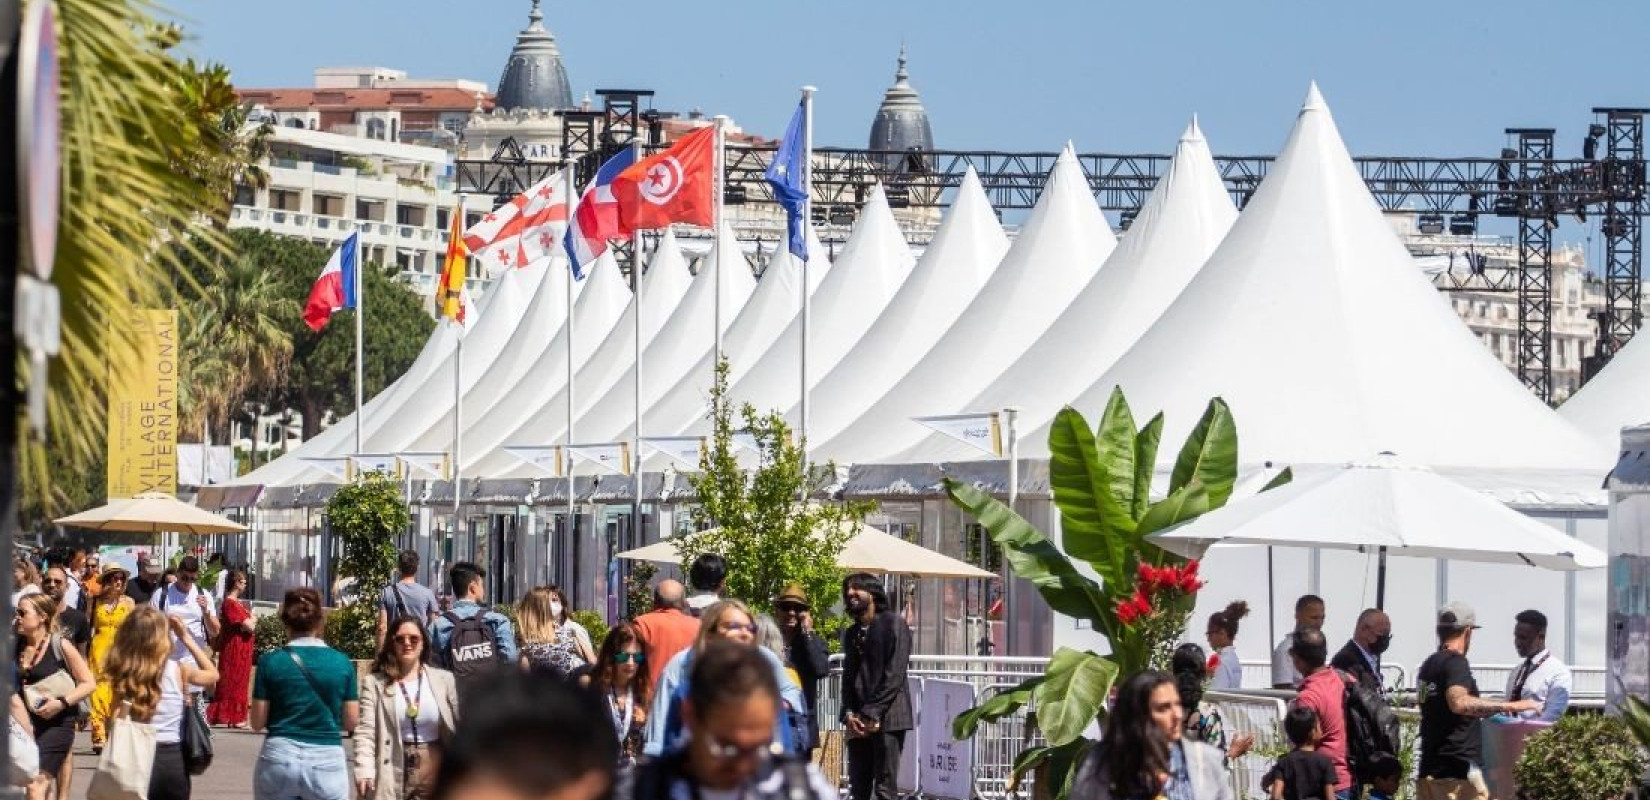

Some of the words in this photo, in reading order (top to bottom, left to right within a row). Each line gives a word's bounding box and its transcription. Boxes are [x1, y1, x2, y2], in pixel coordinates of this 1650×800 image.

[140, 402, 155, 494] VILLAGE
[157, 315, 173, 494] INTERNATIONAL
[452, 641, 493, 662] VANS
